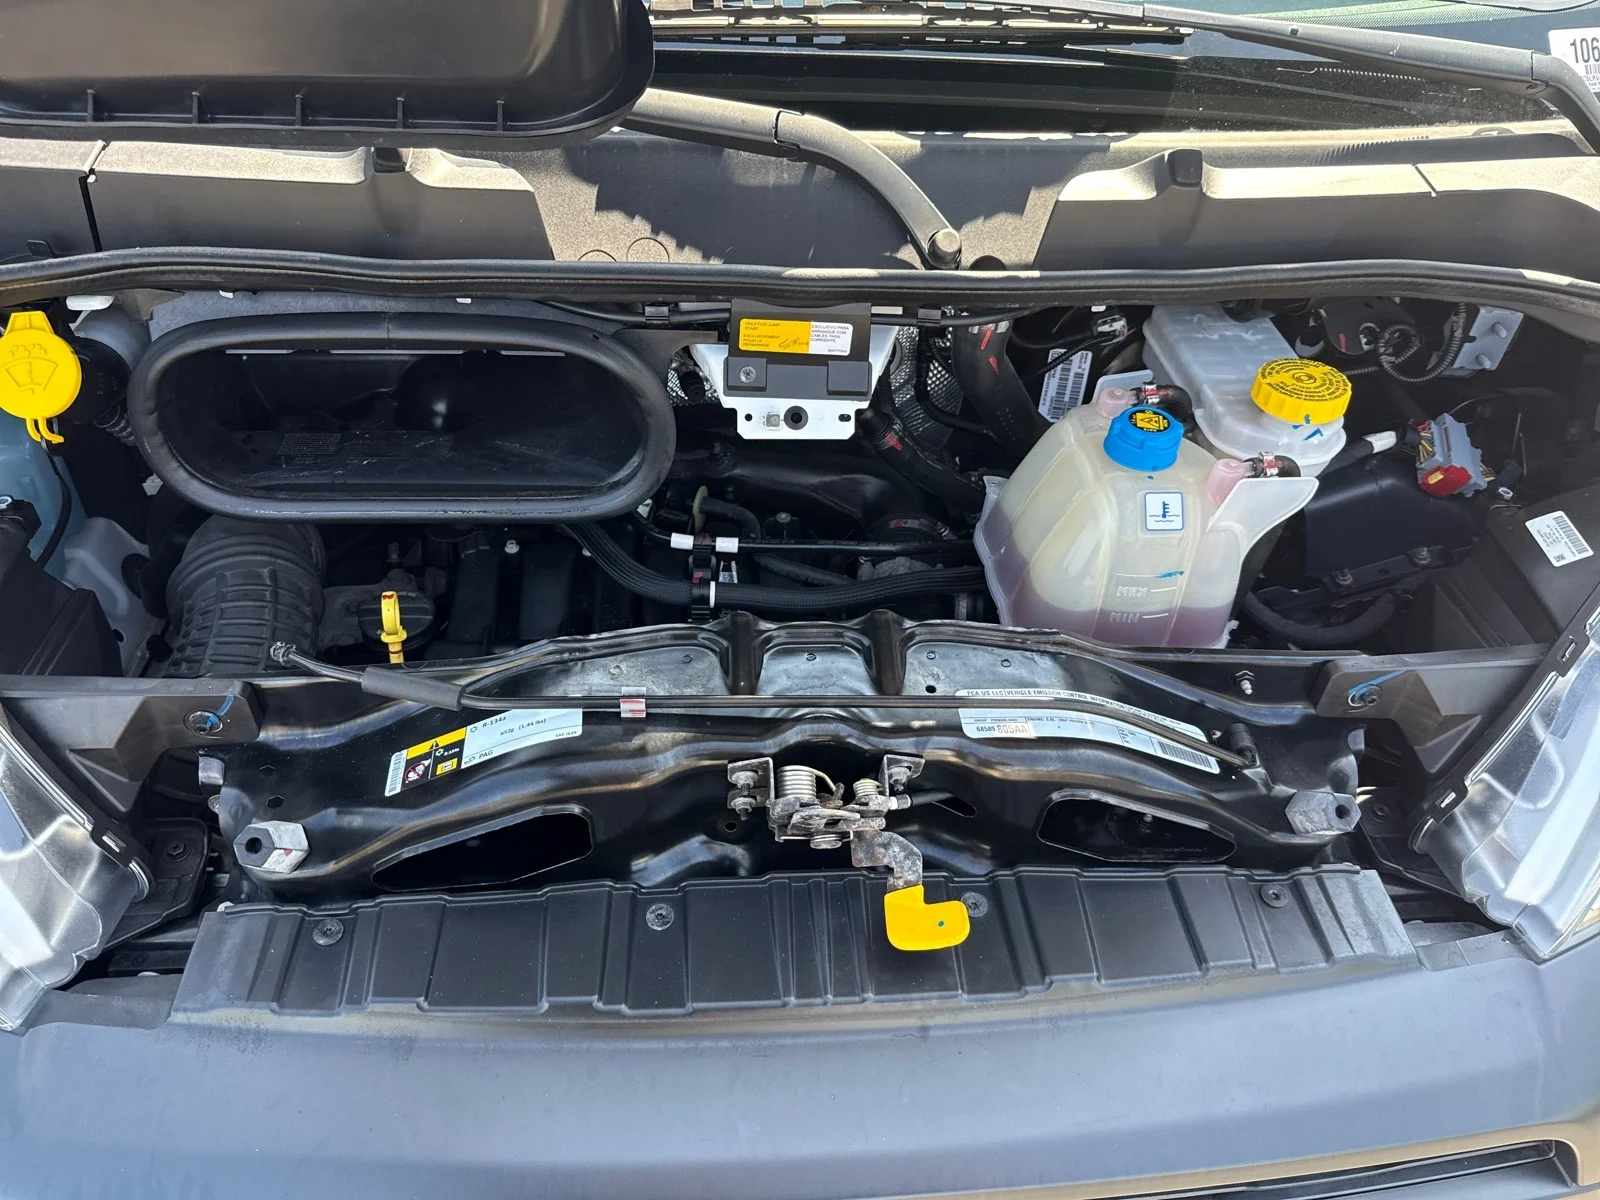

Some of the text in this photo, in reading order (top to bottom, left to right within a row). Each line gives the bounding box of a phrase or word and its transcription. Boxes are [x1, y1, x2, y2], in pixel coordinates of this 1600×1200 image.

[1063, 692, 1088, 700] CONTROL
[1090, 696, 1125, 709] INFORMATION
[482, 716, 507, 728] R-134a
[479, 750, 494, 760] PAG
